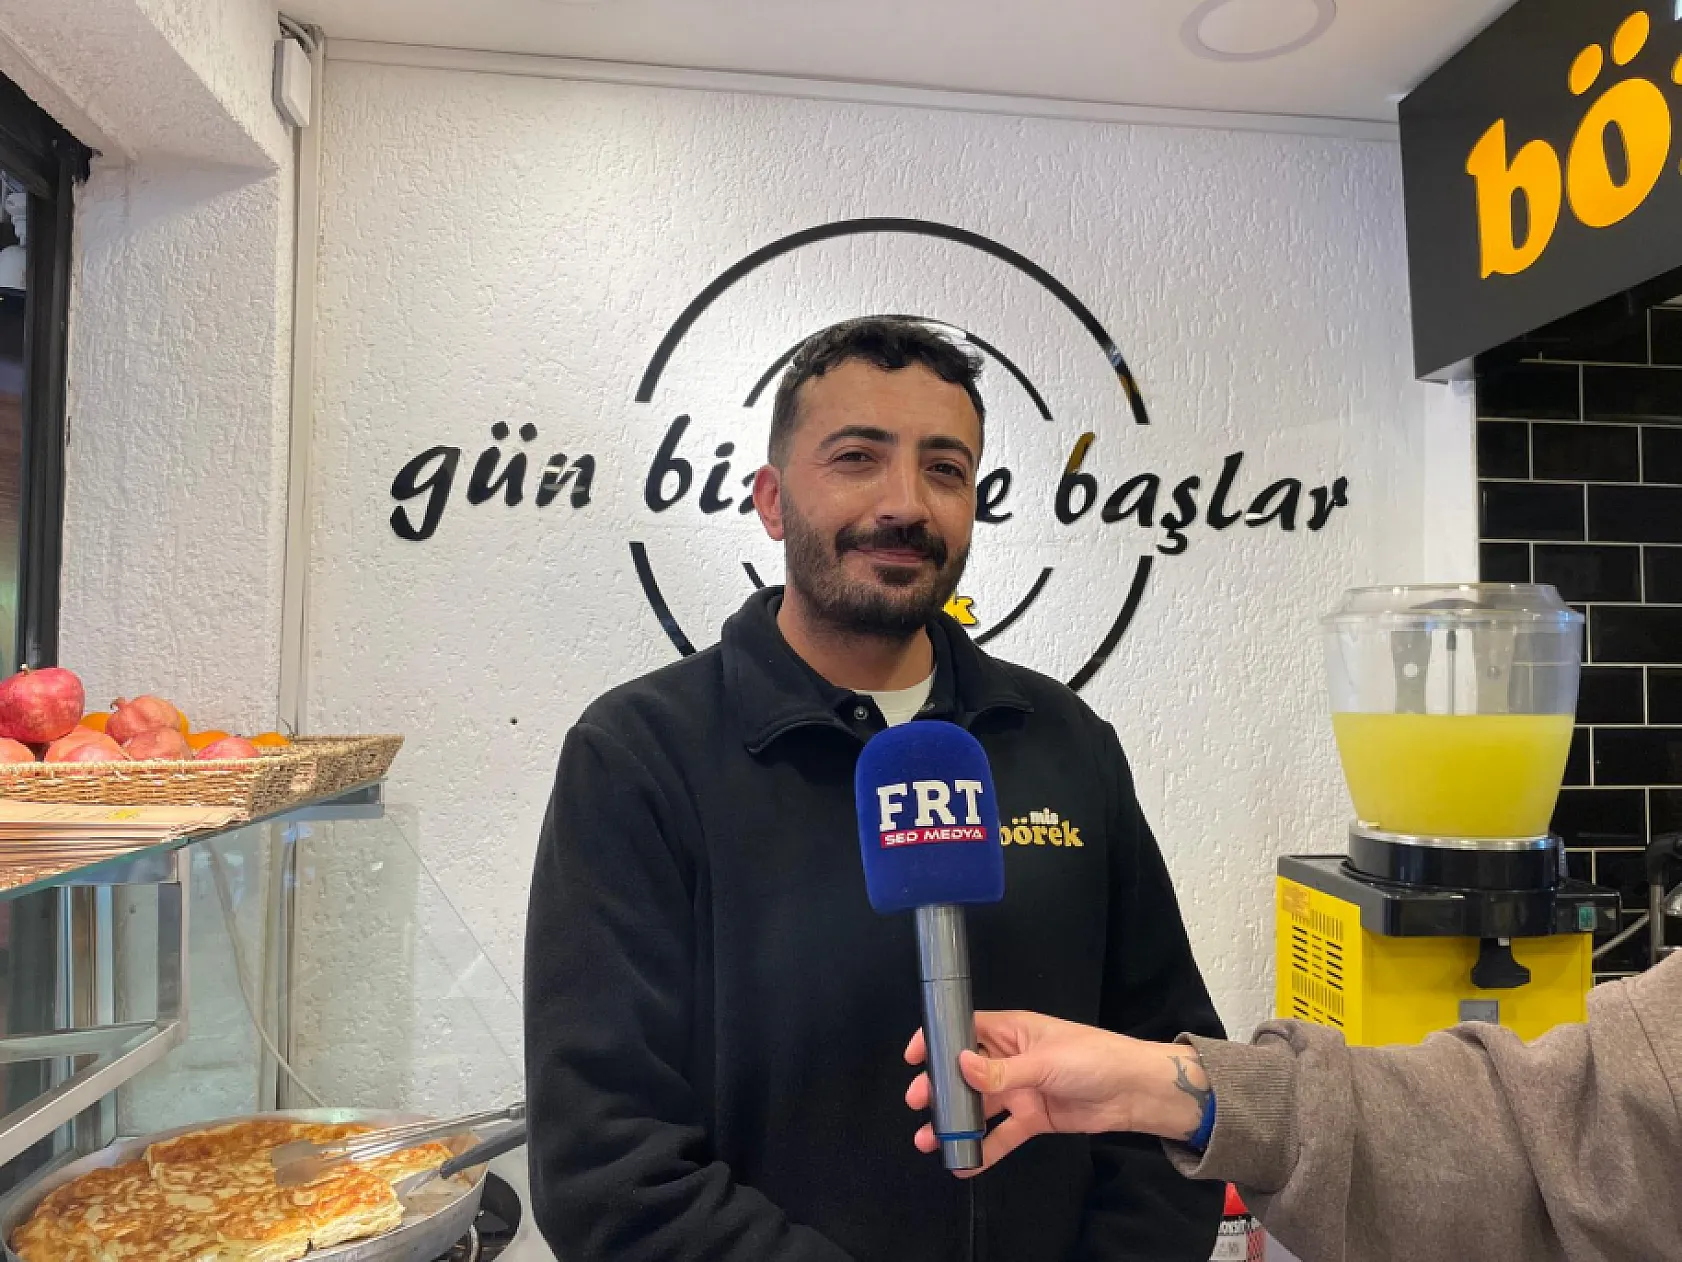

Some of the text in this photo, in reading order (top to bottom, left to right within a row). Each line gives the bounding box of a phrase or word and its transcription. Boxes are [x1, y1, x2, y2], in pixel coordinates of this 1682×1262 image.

[1466, 10, 1682, 280] bö
[390, 420, 595, 541] gün
[1055, 431, 1348, 555] başlar
[877, 779, 983, 832] FRT
[884, 828, 983, 845] SED MEDYA
